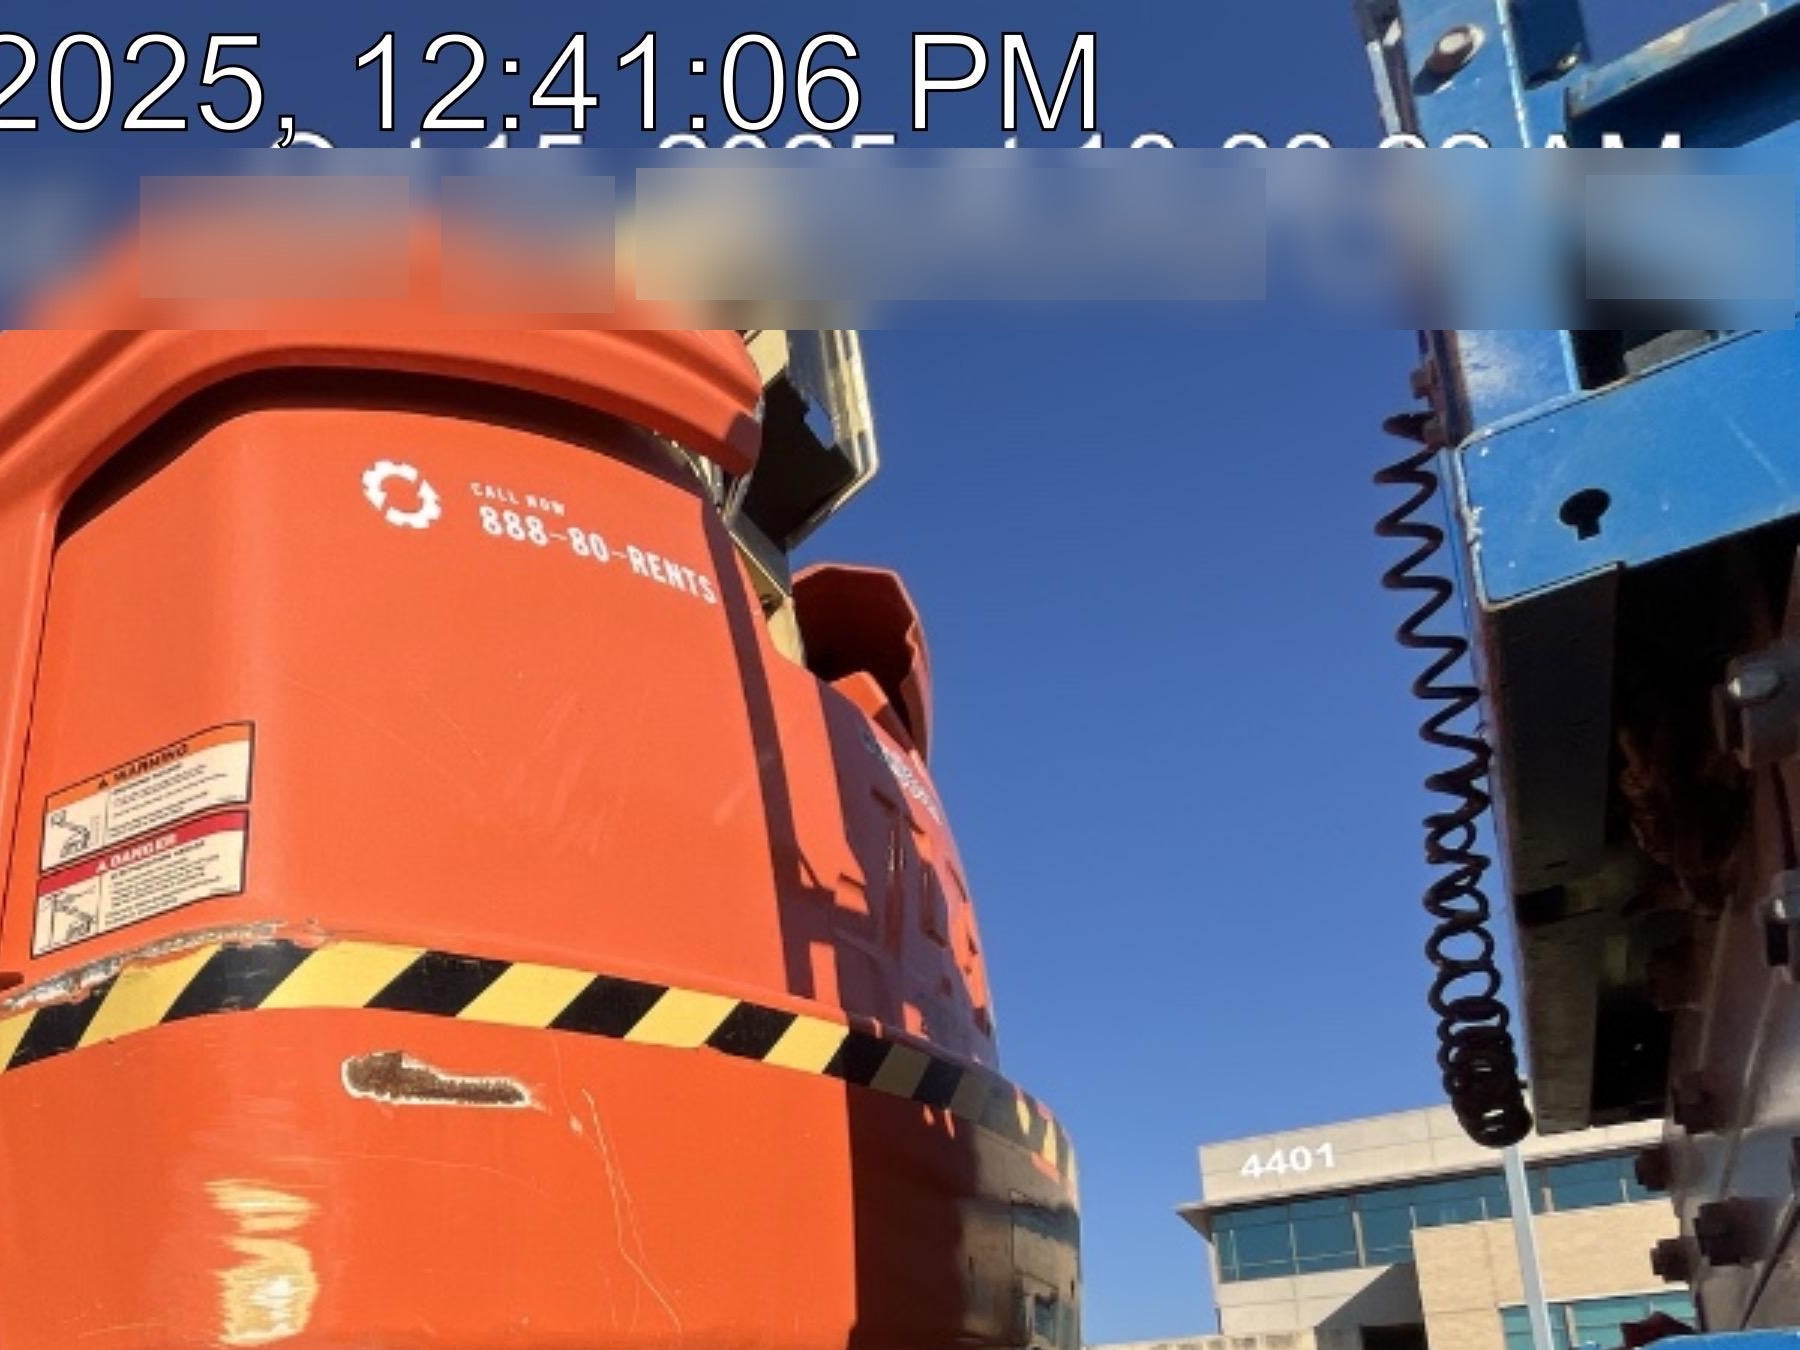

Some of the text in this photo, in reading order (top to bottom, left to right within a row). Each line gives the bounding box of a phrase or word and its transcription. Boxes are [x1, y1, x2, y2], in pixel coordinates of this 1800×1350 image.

[470, 481, 567, 517] CALL NOW
[478, 505, 718, 605] 888-80-RENTS
[113, 743, 189, 782] WARNING
[108, 833, 178, 869] DANGER
[1240, 1141, 1336, 1178] 4401
